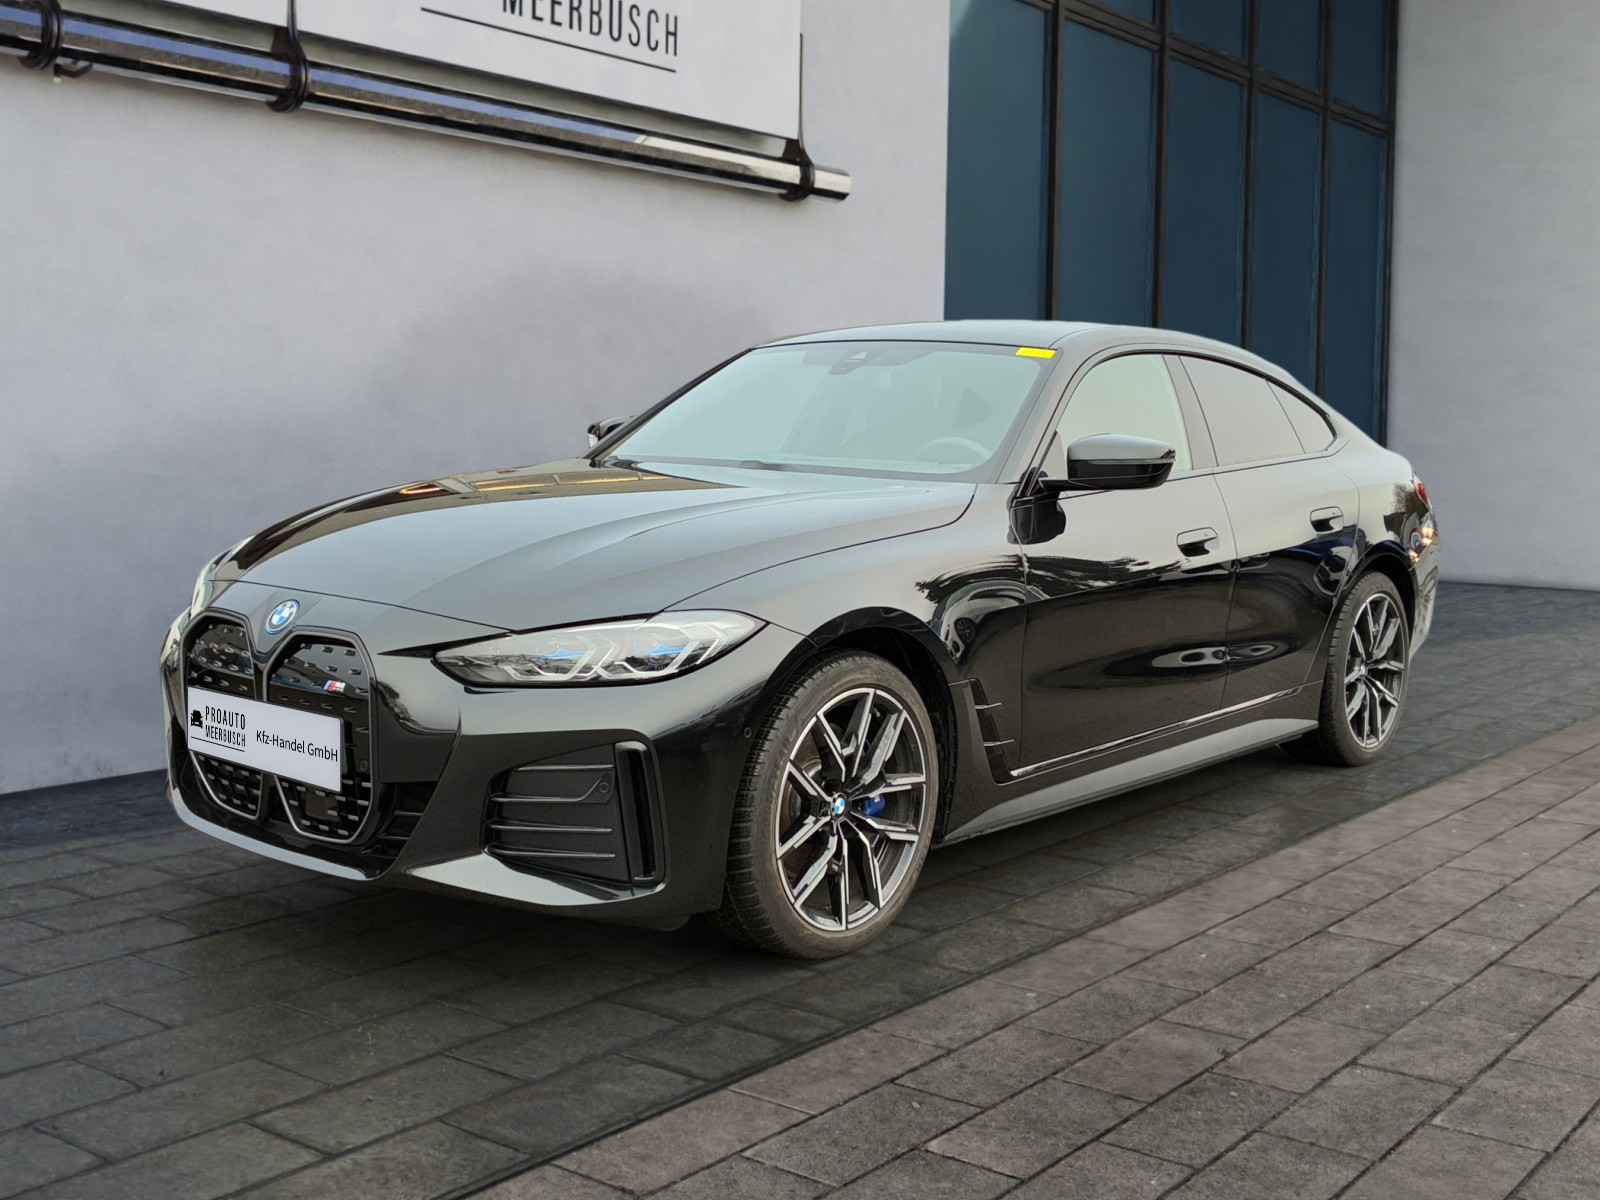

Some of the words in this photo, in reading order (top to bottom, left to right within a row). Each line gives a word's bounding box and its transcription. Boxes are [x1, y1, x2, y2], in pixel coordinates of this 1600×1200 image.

[205, 705, 246, 730] PROAUTO
[205, 724, 246, 748] MEERBUSCH
[256, 730, 305, 754] Kfz-Handel
[307, 742, 338, 762] GmbH
